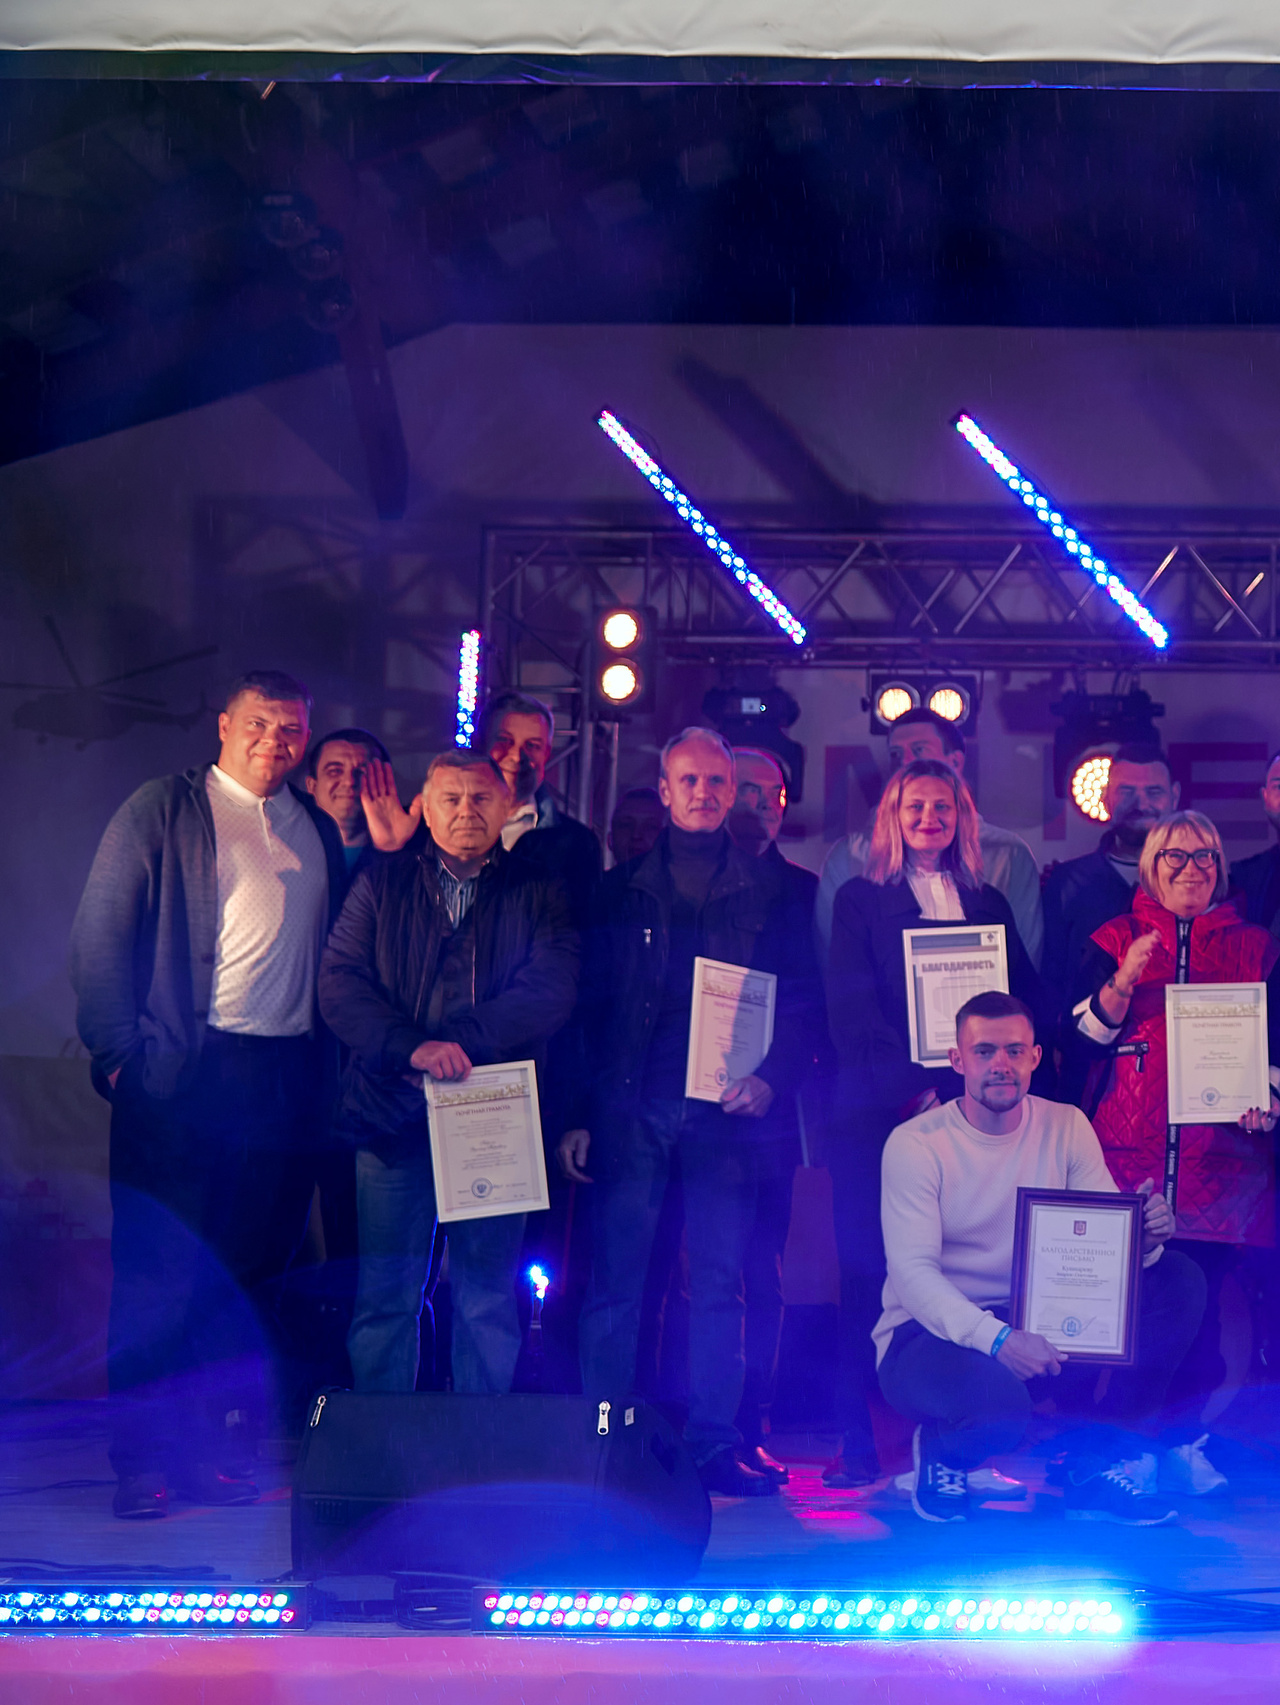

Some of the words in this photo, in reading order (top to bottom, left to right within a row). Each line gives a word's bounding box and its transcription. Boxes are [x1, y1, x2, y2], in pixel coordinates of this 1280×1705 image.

[921, 959, 995, 973] БЛАГОДАРНОСТЬ
[1040, 1246, 1116, 1257] БЛАГОДАРСТВЕННОЕ
[1061, 1254, 1095, 1263] ПИСЬМО
